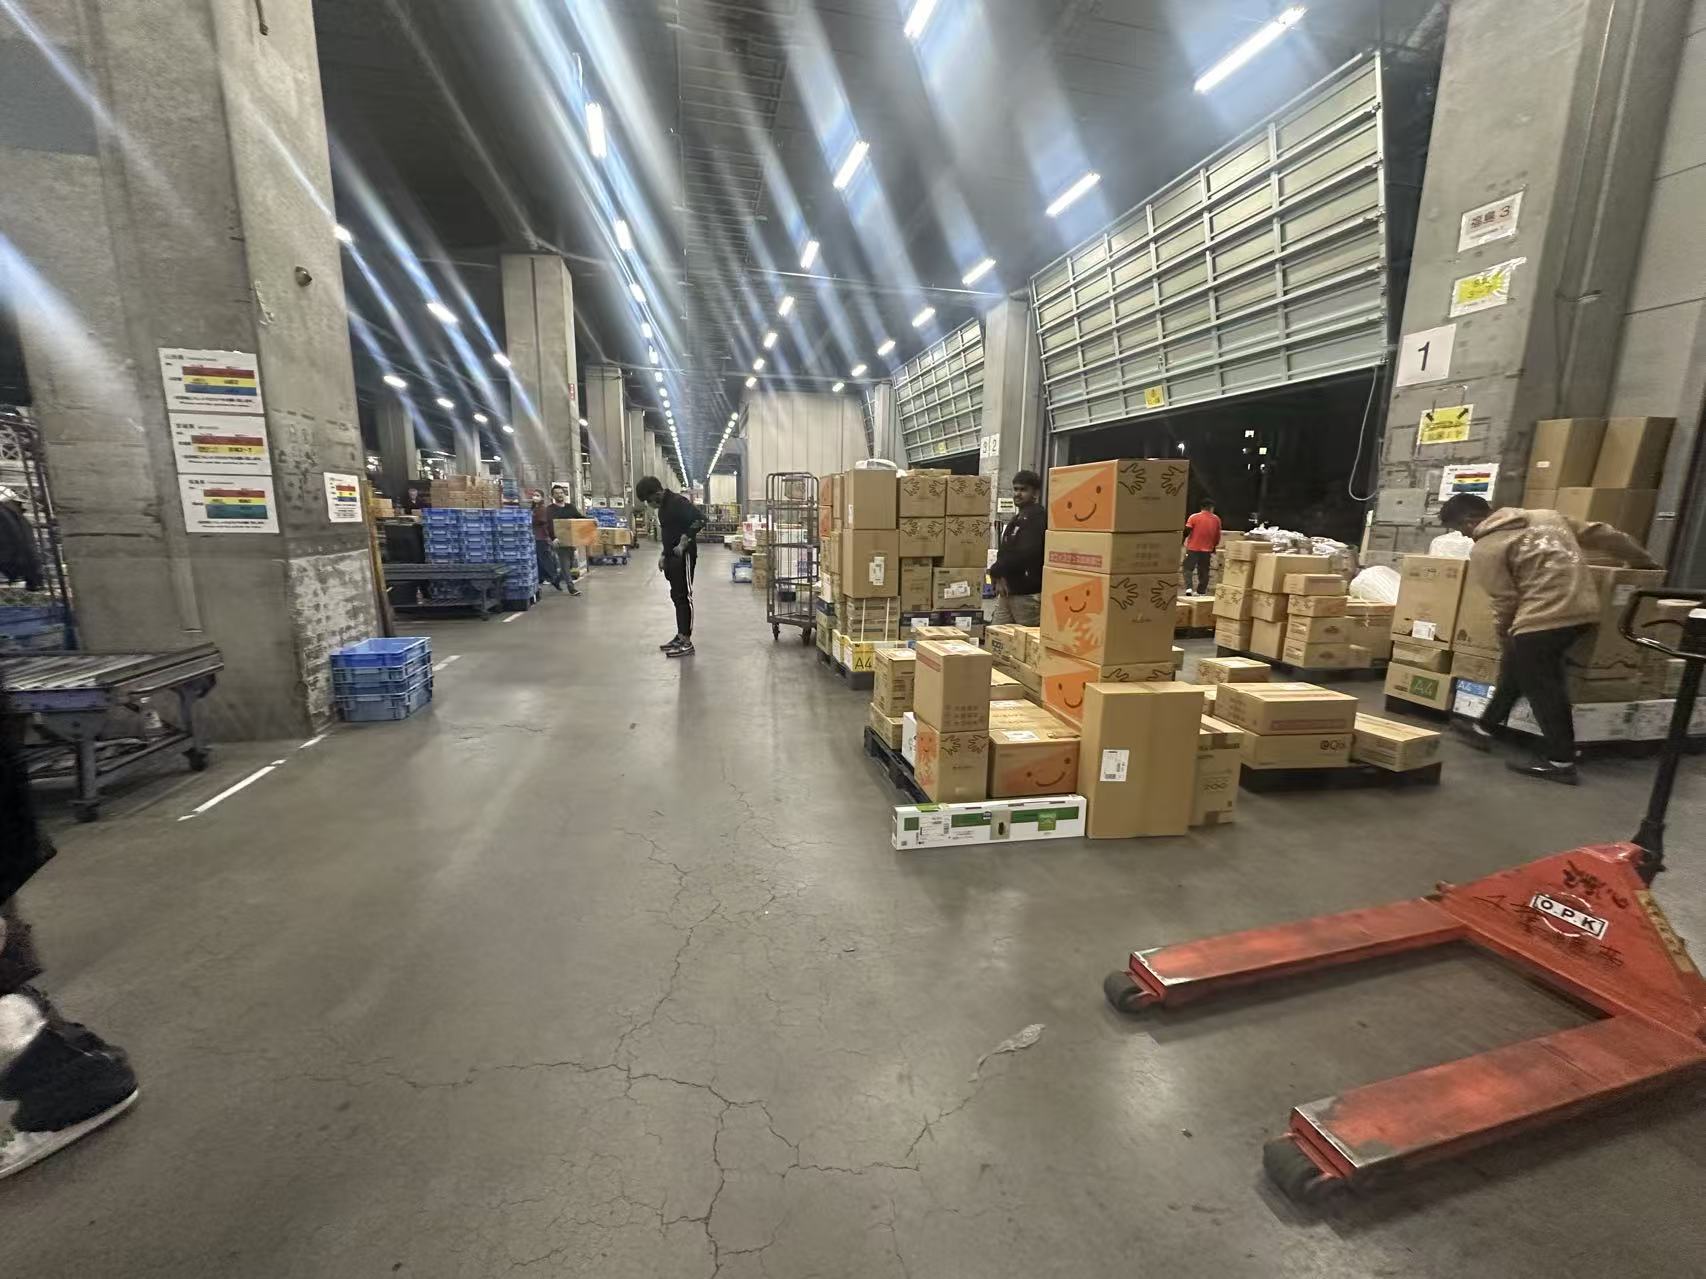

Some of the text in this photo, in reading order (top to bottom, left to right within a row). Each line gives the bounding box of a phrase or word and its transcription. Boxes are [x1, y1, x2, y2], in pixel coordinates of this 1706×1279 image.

[1417, 340, 1430, 371] 1
[854, 656, 872, 670] A4
[1540, 898, 1596, 931] O.P.K
